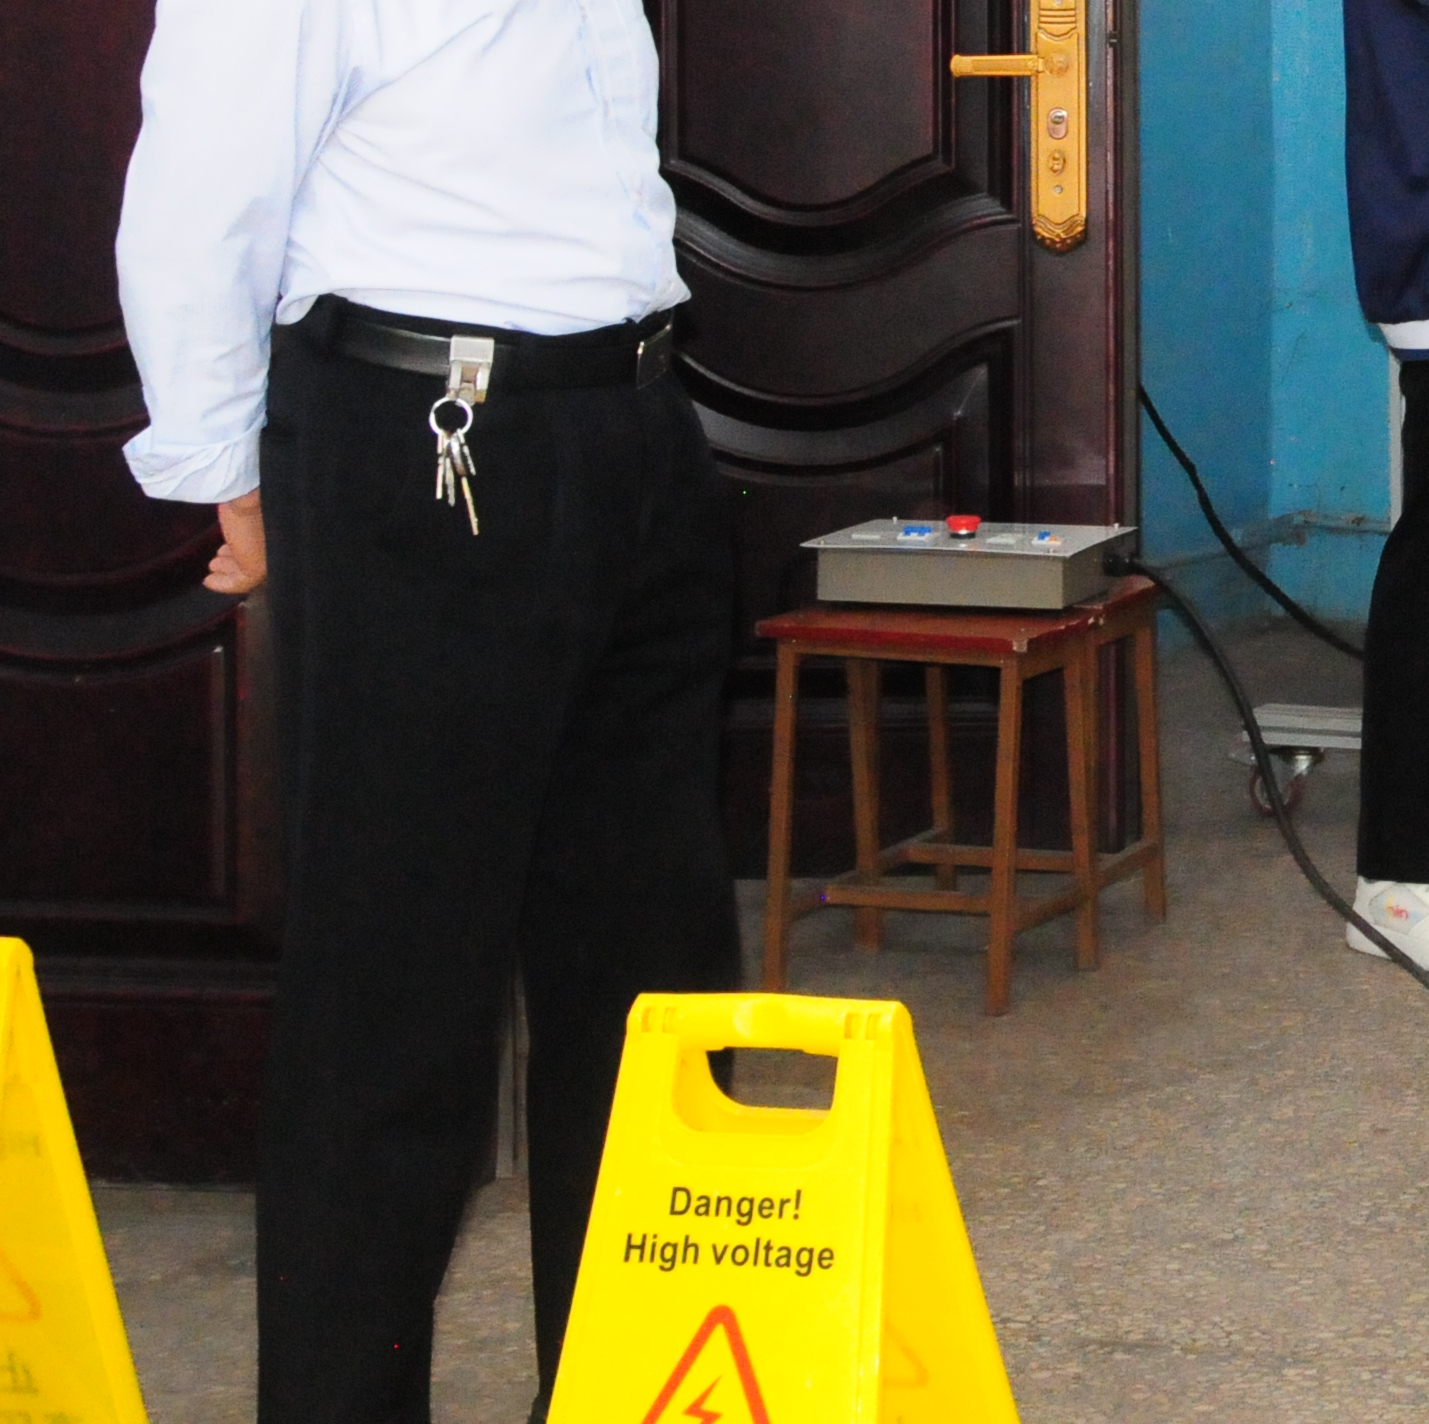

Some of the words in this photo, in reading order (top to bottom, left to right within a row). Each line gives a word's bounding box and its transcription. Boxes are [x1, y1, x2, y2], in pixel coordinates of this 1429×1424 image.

[669, 1186, 803, 1227] Danger!
[623, 1232, 700, 1273] High
[713, 1237, 836, 1277] voltage
